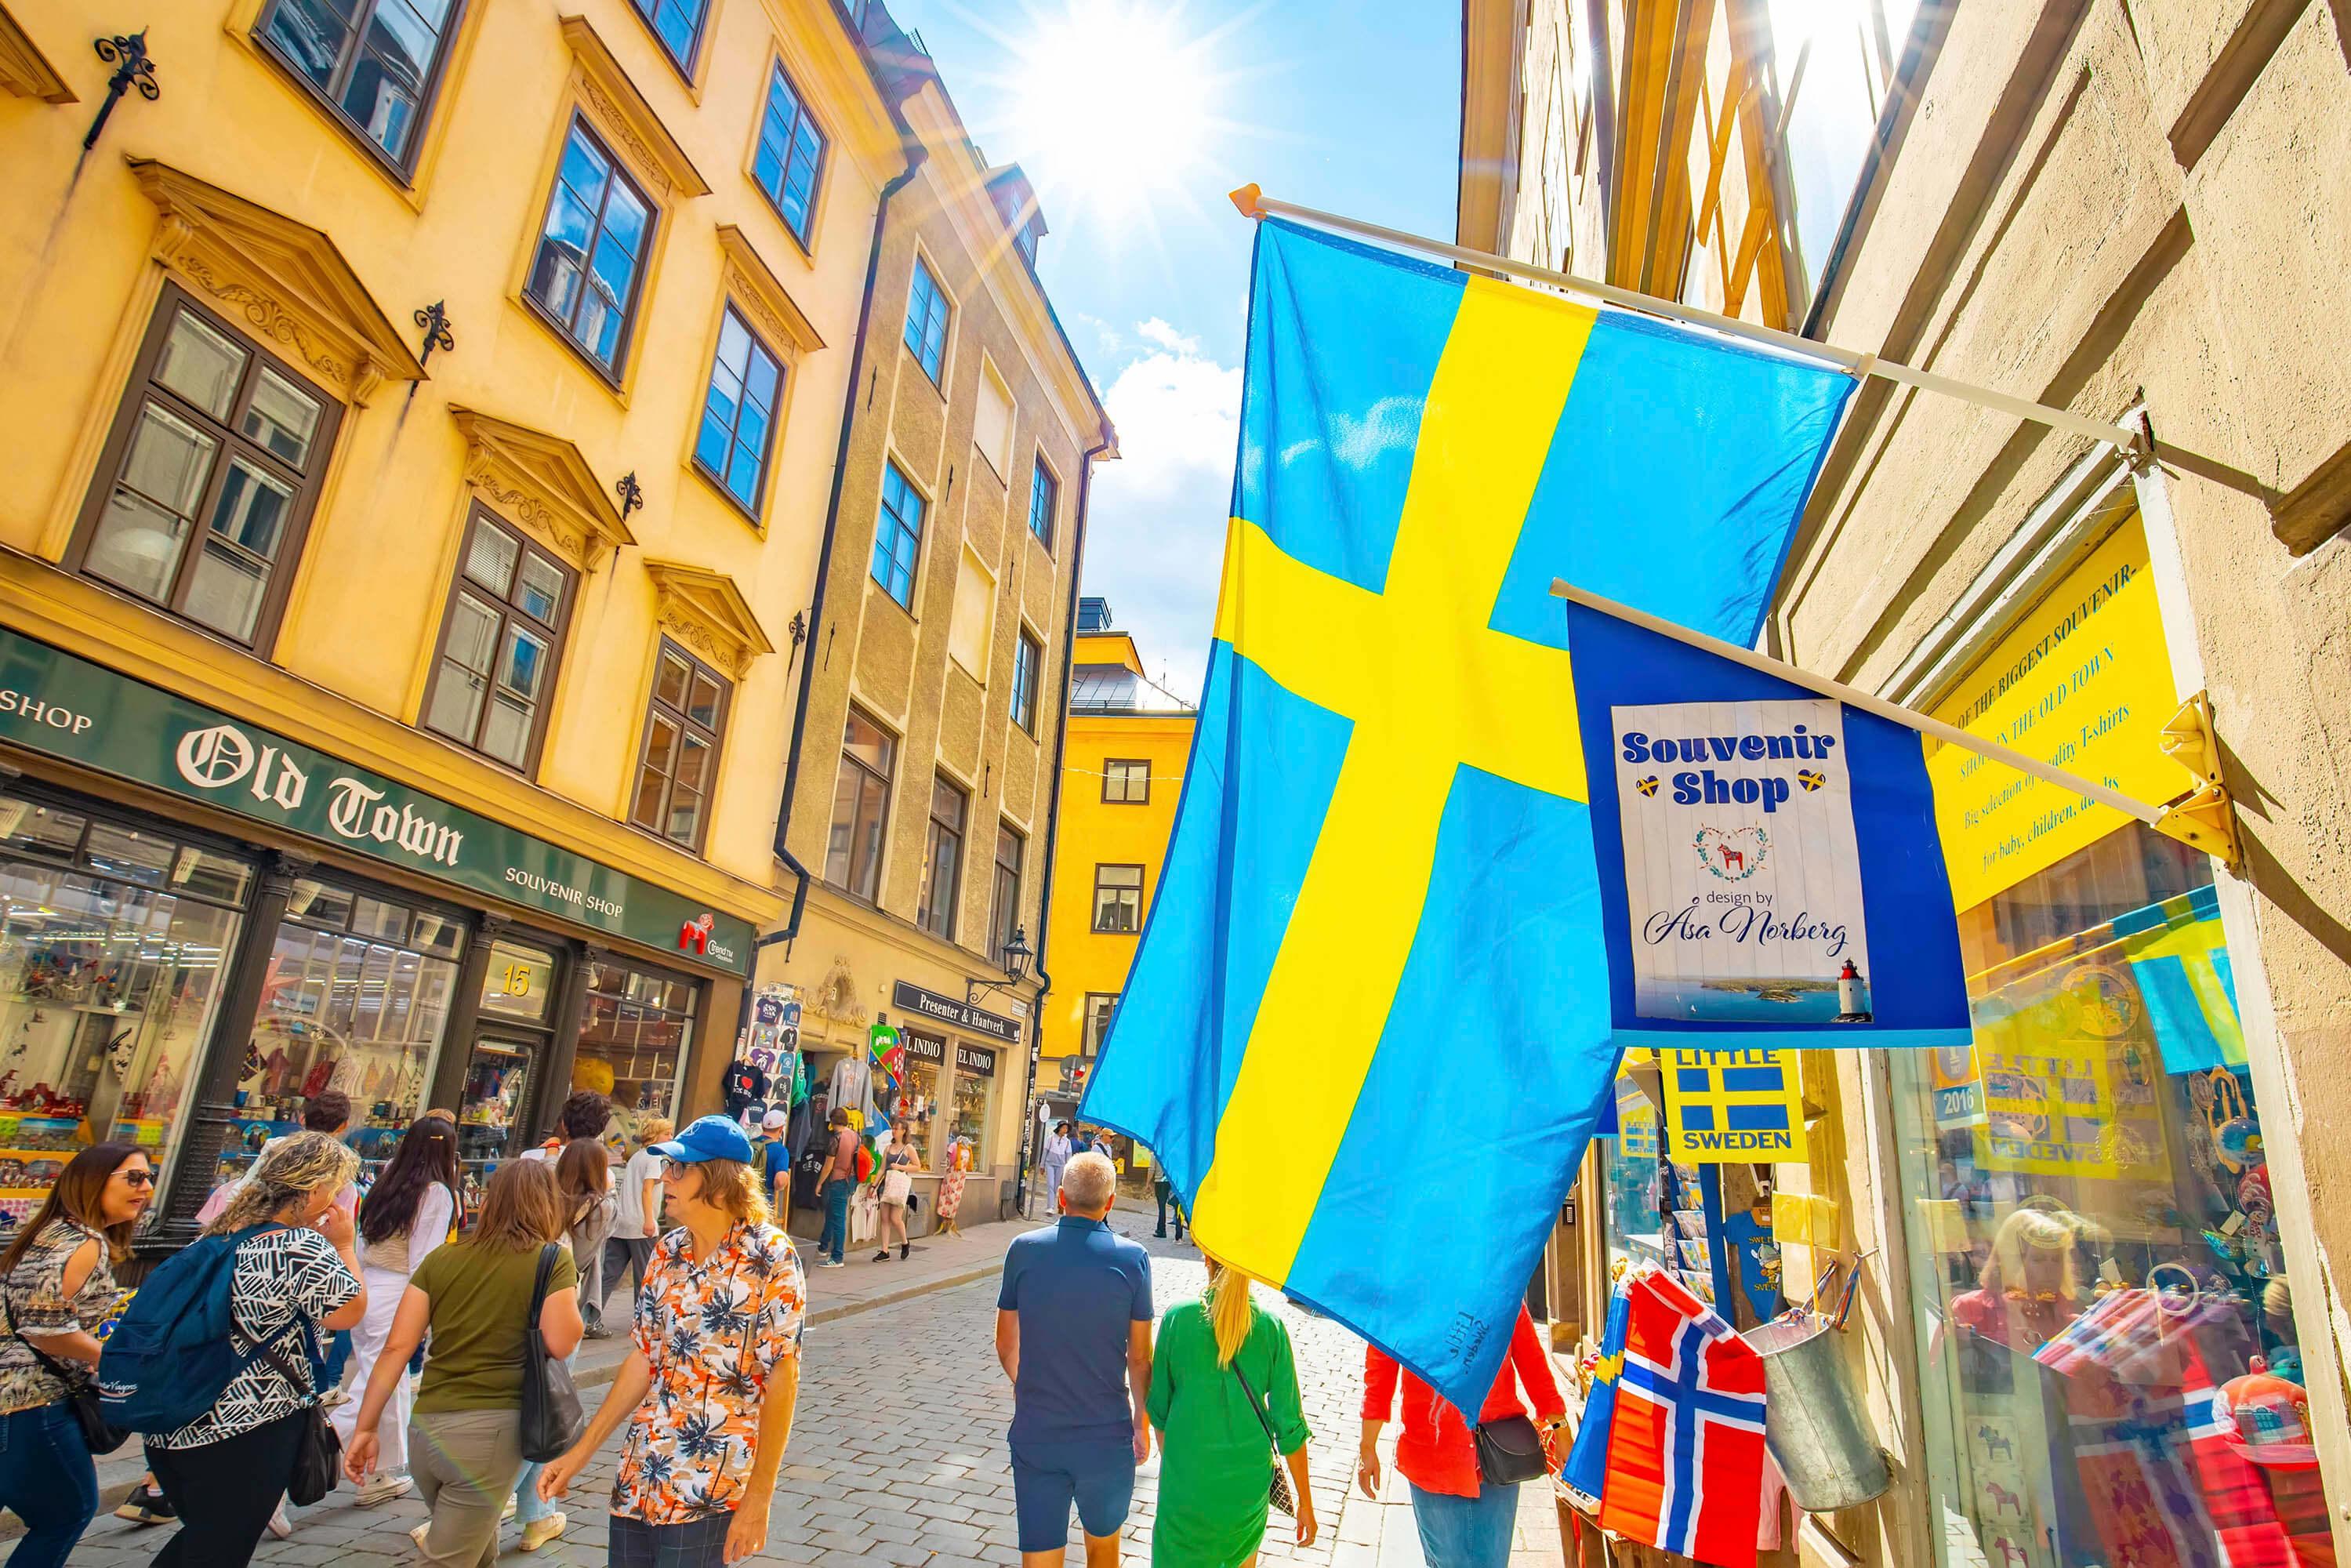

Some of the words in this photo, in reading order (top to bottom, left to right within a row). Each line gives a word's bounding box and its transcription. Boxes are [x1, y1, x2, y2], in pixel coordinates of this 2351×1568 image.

[1973, 685, 1995, 718] THE
[1998, 635, 2050, 697] BIGGEST
[2012, 706, 2036, 740] THE
[2040, 684, 2066, 718] OLD
[2071, 642, 2114, 693] TOWN
[0, 690, 93, 735] SHOP
[1622, 724, 1835, 764] Souvenir
[1965, 809, 1979, 829] Big
[1981, 780, 2022, 817] selection
[2081, 703, 2129, 748] T-shirts
[176, 724, 309, 810] Old
[328, 777, 464, 866] Town
[1673, 770, 1789, 813] Shop
[1983, 851, 1997, 873] for
[505, 867, 582, 906] SOUVENIR
[586, 895, 623, 917] SHOP
[1707, 891, 1751, 909] design
[1755, 891, 1772, 908] by
[1643, 897, 1711, 946] Åsa
[1718, 906, 1849, 956] Norberg
[502, 962, 531, 997] 15
[920, 993, 959, 1019] Presenter
[961, 1009, 969, 1023] &
[972, 1011, 1004, 1034] Hantverk
[905, 1036, 912, 1051] L
[914, 1037, 940, 1058] INDIO
[958, 1049, 968, 1064] EL
[969, 1052, 991, 1070] INDIO
[1675, 1049, 1781, 1065] LITTLE
[1944, 1088, 1974, 1114] 2016
[1683, 1131, 1792, 1149] SWEDEN
